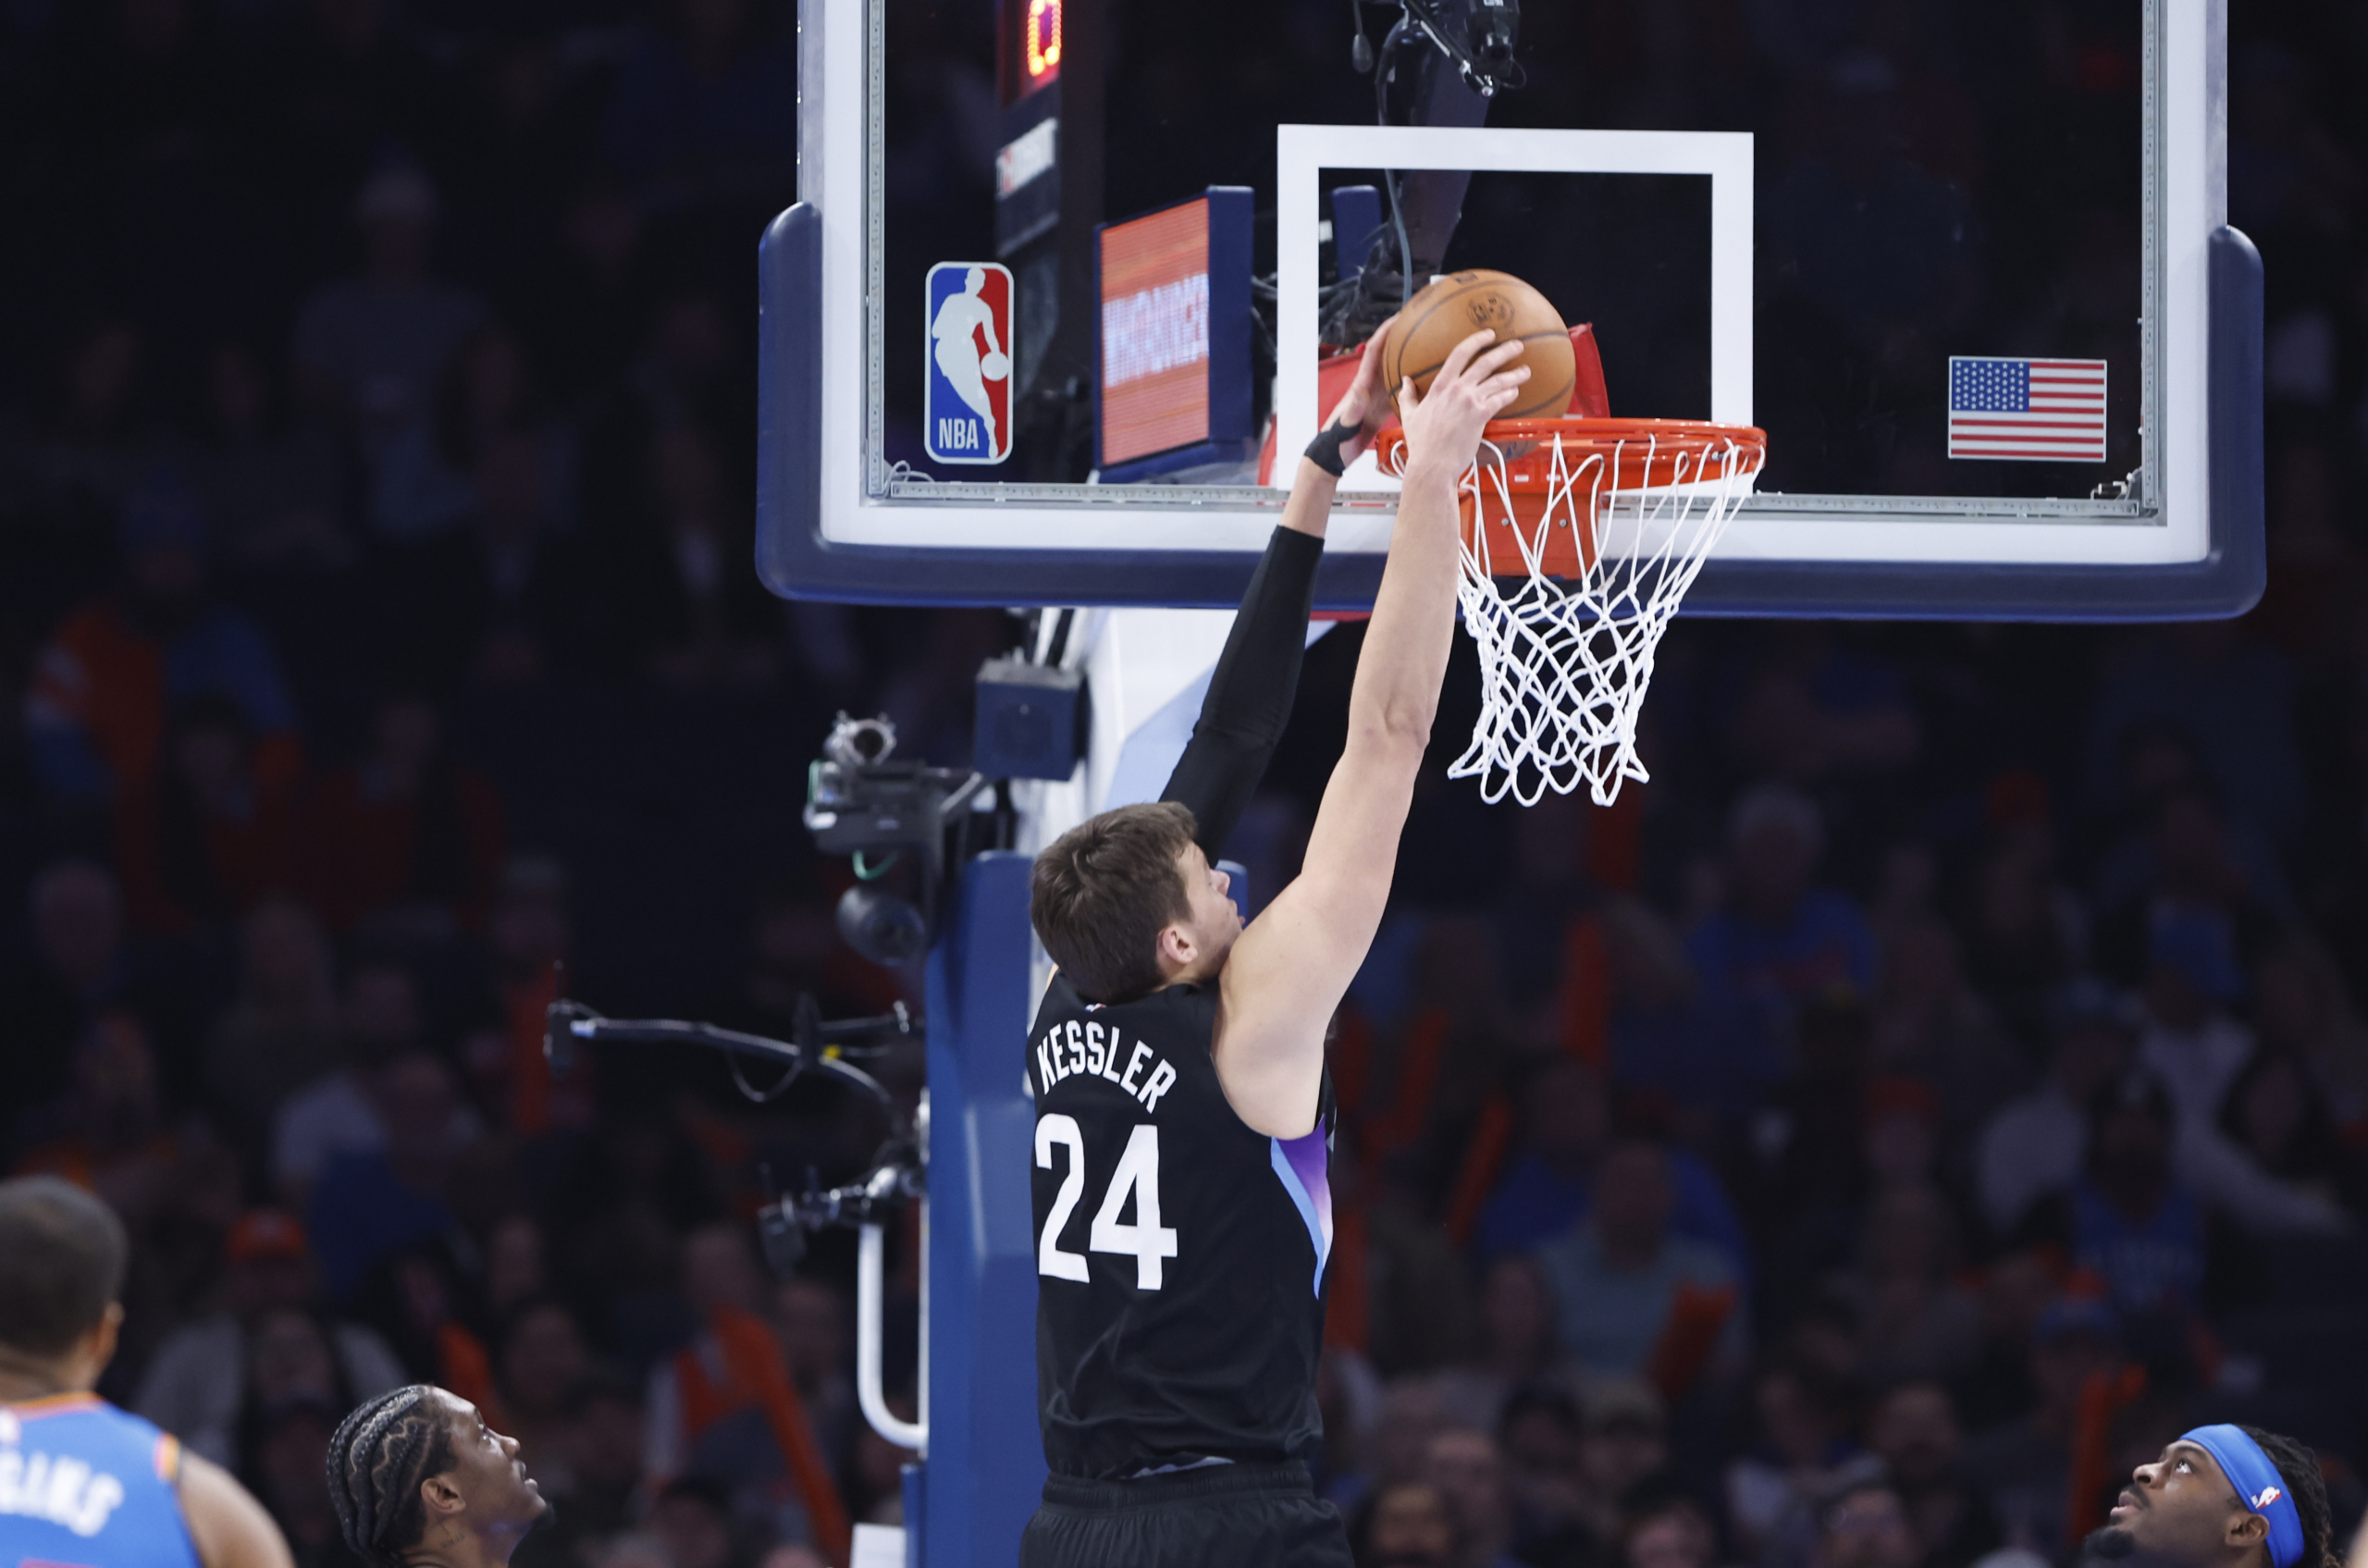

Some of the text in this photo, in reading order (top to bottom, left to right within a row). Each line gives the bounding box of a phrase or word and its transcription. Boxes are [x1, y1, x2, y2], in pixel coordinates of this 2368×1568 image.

[939, 417, 980, 451] NBA
[1037, 1019, 1178, 1114] KESSLER
[1035, 1113, 1178, 1290] 24
